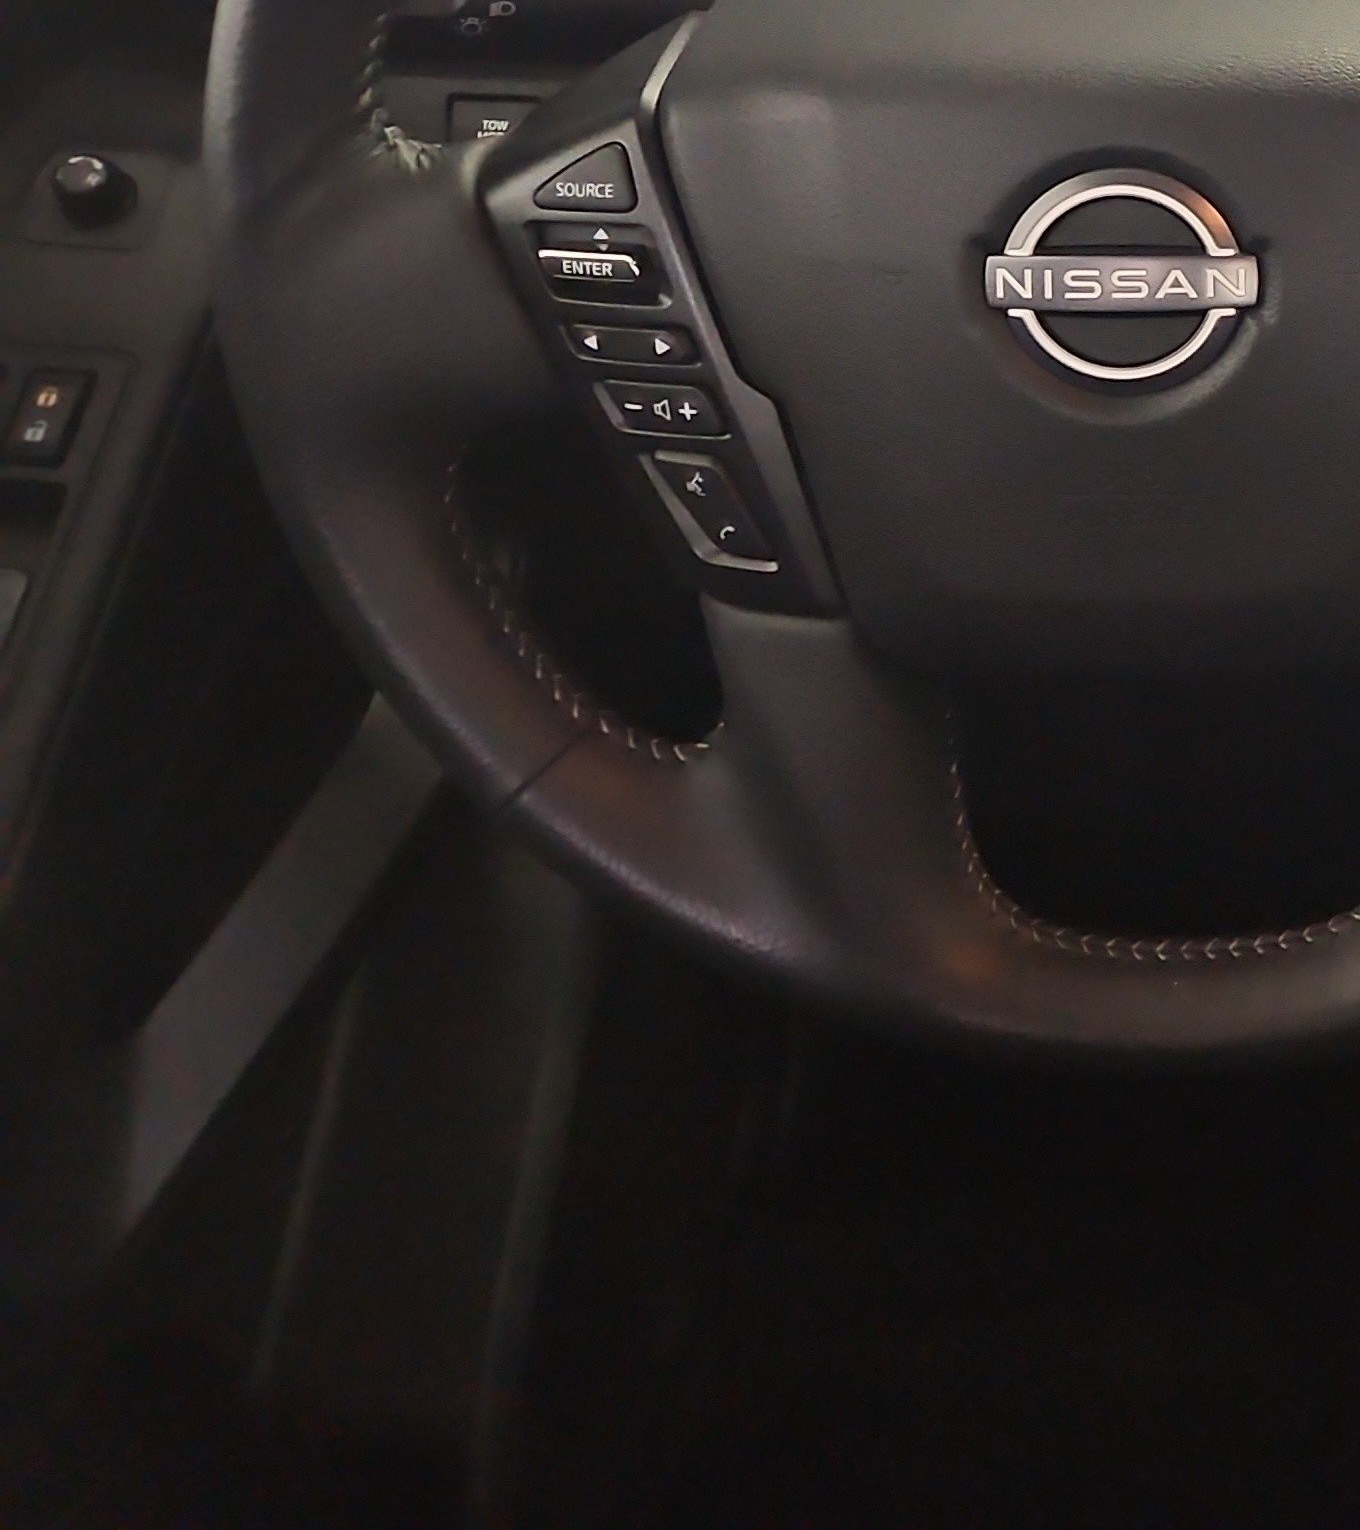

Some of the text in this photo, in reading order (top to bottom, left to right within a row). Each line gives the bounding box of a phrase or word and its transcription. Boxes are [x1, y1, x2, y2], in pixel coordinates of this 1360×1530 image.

[482, 119, 509, 133] TOW
[555, 181, 615, 199] SOURCE
[562, 259, 615, 278] ENTER
[995, 267, 1248, 300] NISSAN
